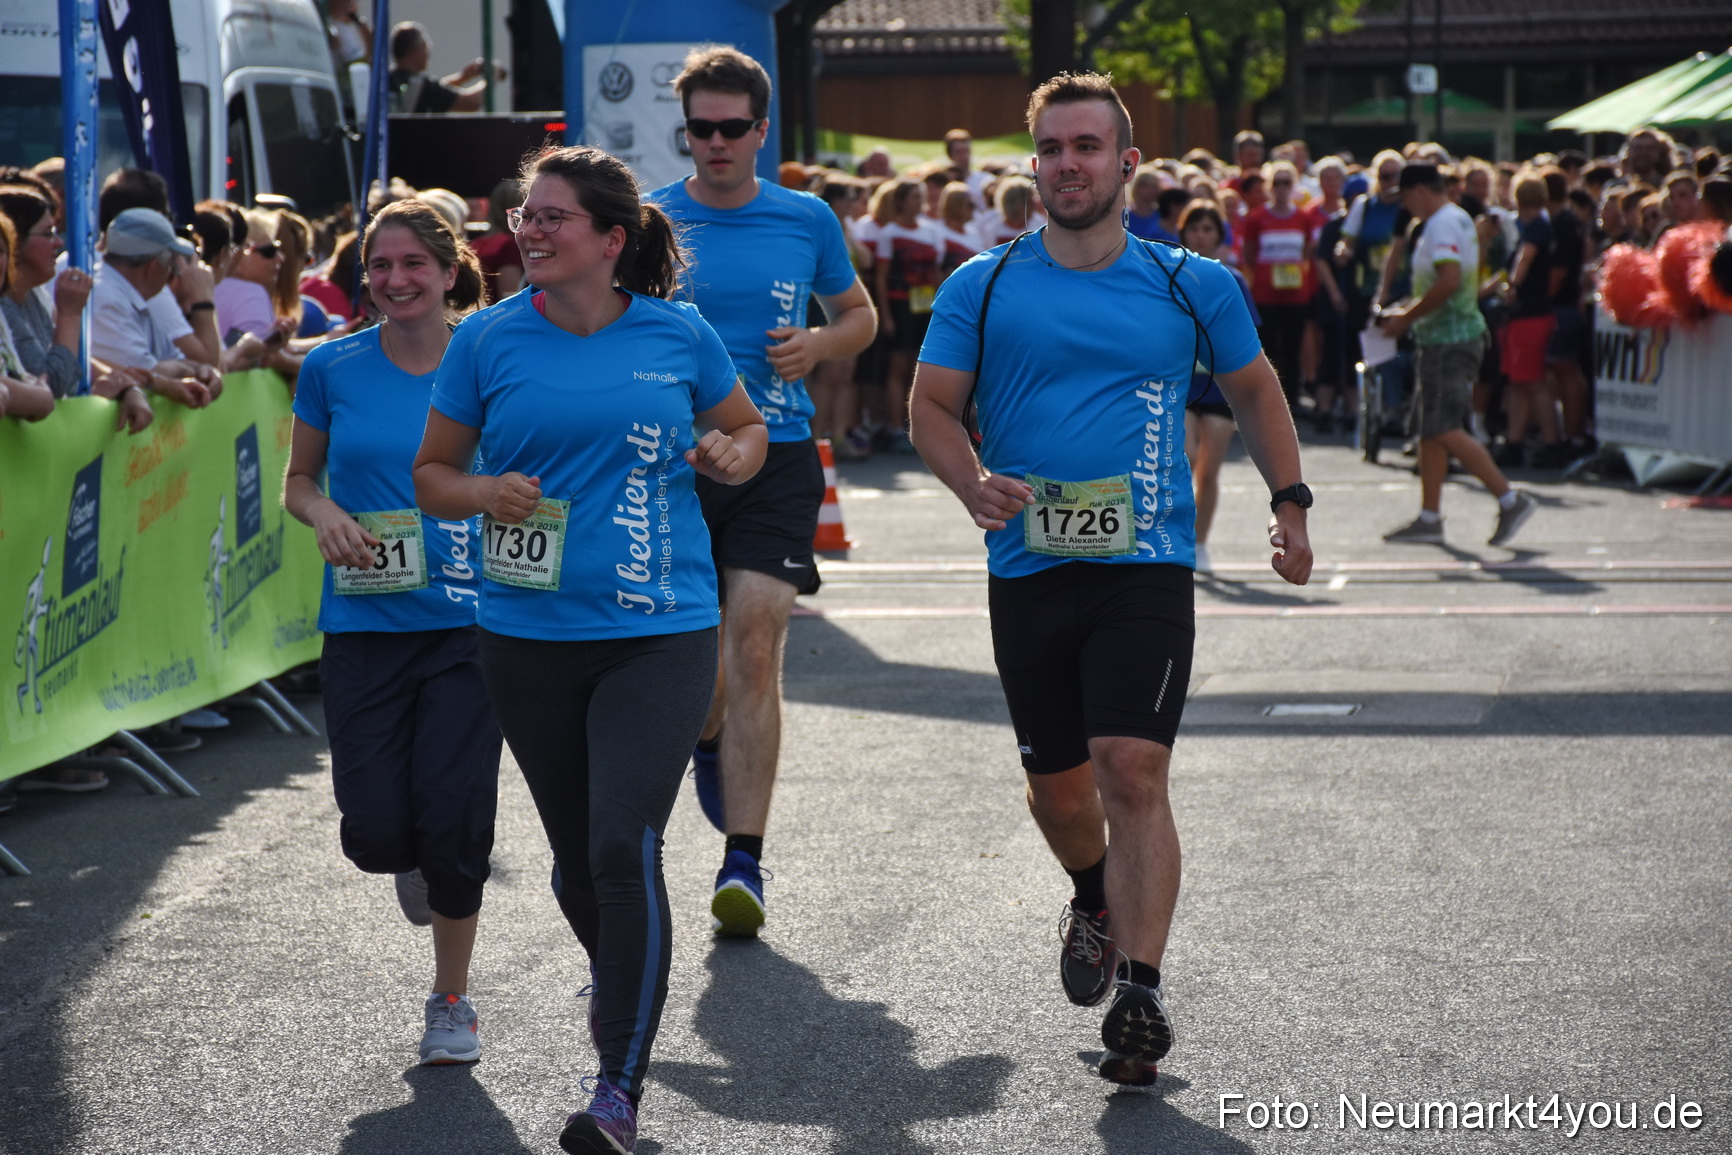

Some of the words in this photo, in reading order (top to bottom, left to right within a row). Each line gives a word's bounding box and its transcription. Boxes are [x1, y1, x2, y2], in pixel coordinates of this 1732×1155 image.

[489, 307, 506, 317] JAKO
[344, 341, 360, 350] JAKO
[633, 370, 678, 384] Nathalie
[1135, 379, 1164, 416] di
[627, 422, 662, 463] di
[1132, 418, 1161, 531] bedien
[1105, 498, 1126, 507] 2019
[537, 523, 558, 532] 2019
[613, 466, 651, 584] bedien
[1036, 506, 1120, 536] 1726
[1155, 489, 1175, 556] Nathalies
[395, 531, 416, 539] 2019
[486, 522, 547, 563] 1730
[1046, 535, 1066, 544] Dietz
[1069, 536, 1112, 544] Alexander
[438, 520, 475, 580] bed
[341, 572, 383, 581] Lengenfelder
[385, 570, 414, 579] Sophie
[501, 568, 531, 579] Lengenfelder
[514, 561, 549, 574] Nathalie
[658, 538, 677, 613] Nathalies
[44, 544, 126, 672] firmenlauf
